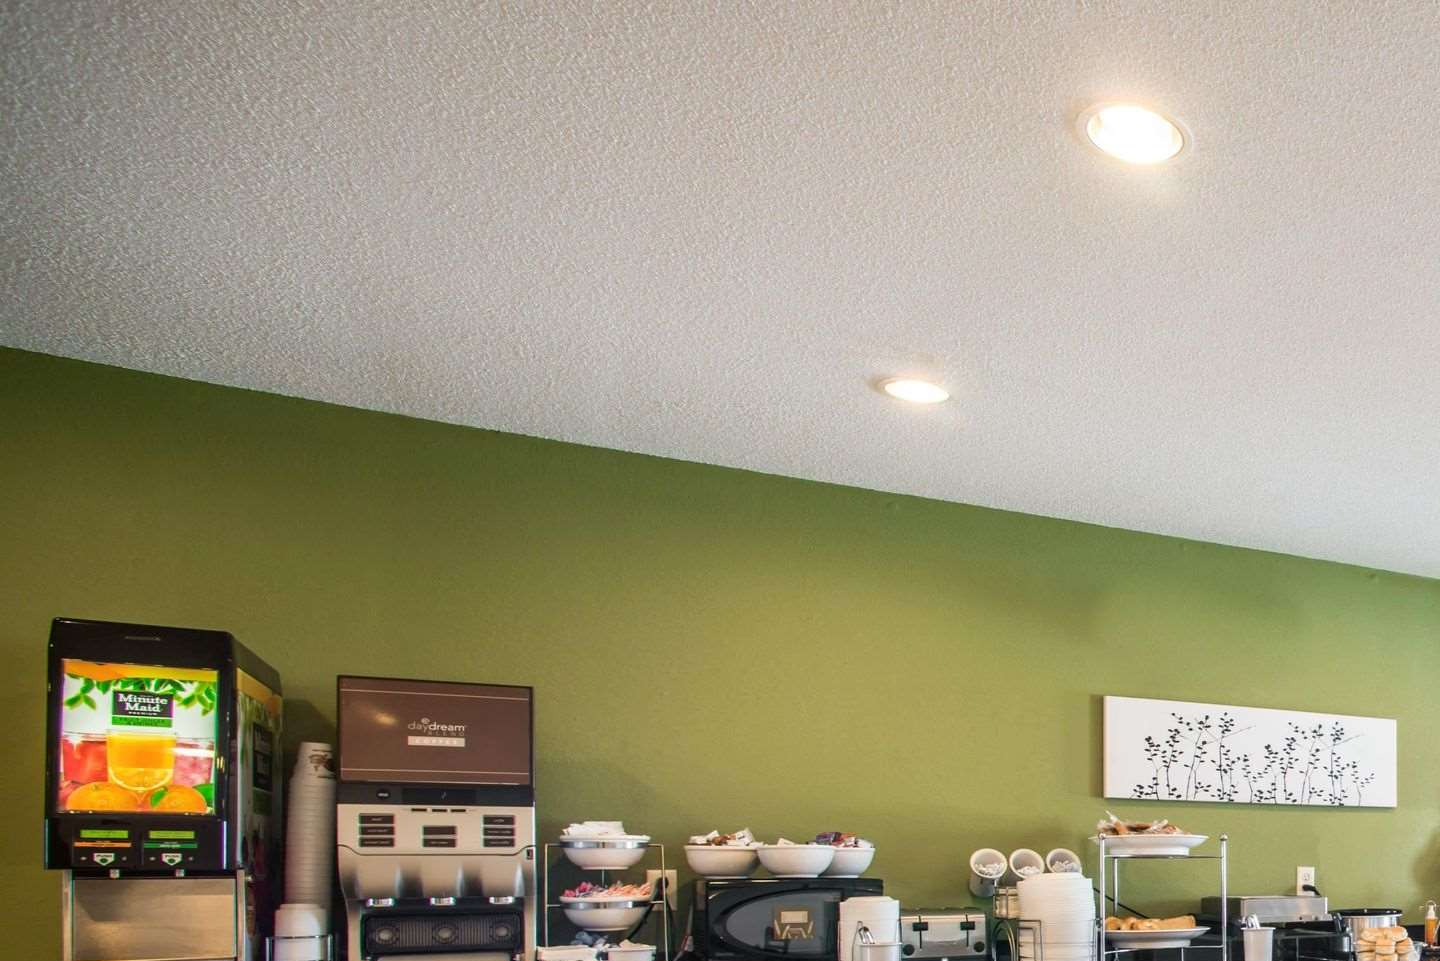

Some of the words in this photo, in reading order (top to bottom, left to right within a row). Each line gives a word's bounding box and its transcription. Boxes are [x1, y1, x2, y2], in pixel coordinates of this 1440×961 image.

[118, 693, 168, 704] Minute
[125, 702, 161, 712] Maid
[408, 719, 465, 733] daydream
